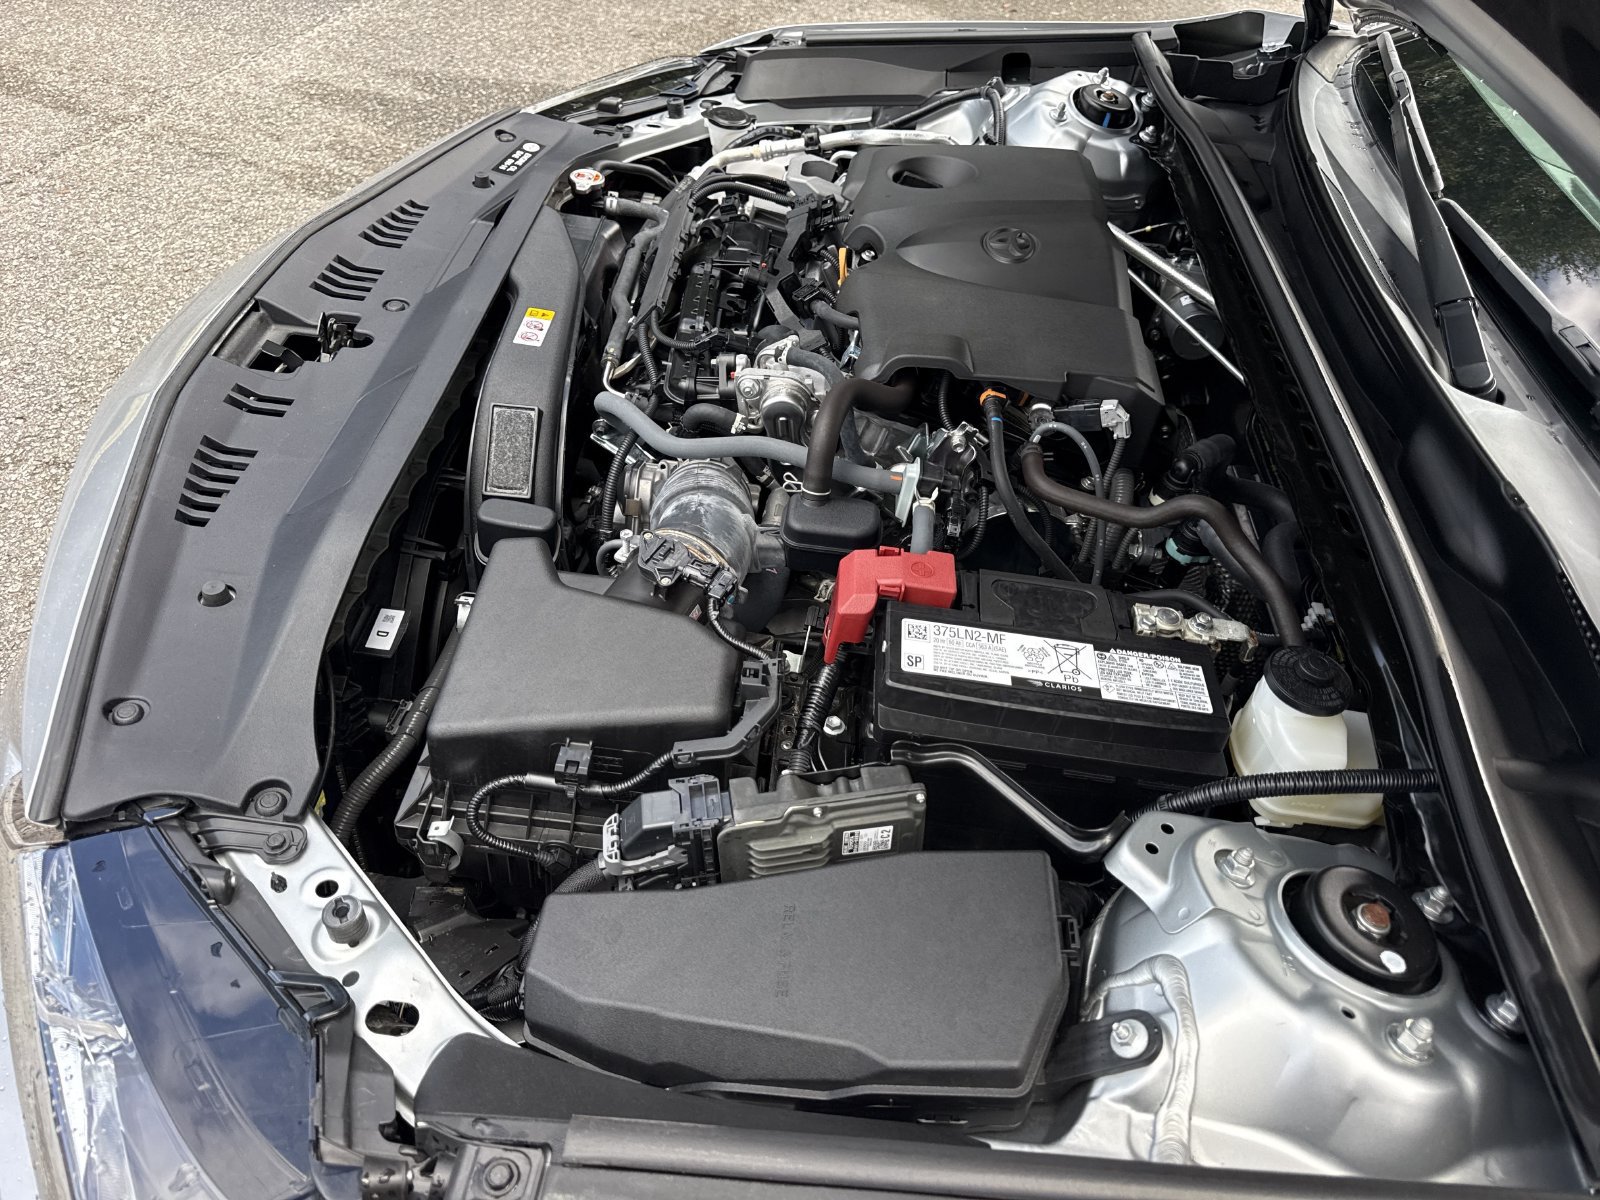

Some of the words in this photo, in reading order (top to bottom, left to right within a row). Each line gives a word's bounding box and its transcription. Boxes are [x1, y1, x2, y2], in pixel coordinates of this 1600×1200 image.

[376, 630, 390, 638] D
[933, 624, 1006, 645] 375LN2-MF
[907, 655, 922, 667] SP
[1064, 675, 1079, 683] Pb
[1044, 682, 1083, 692] CLARIOS
